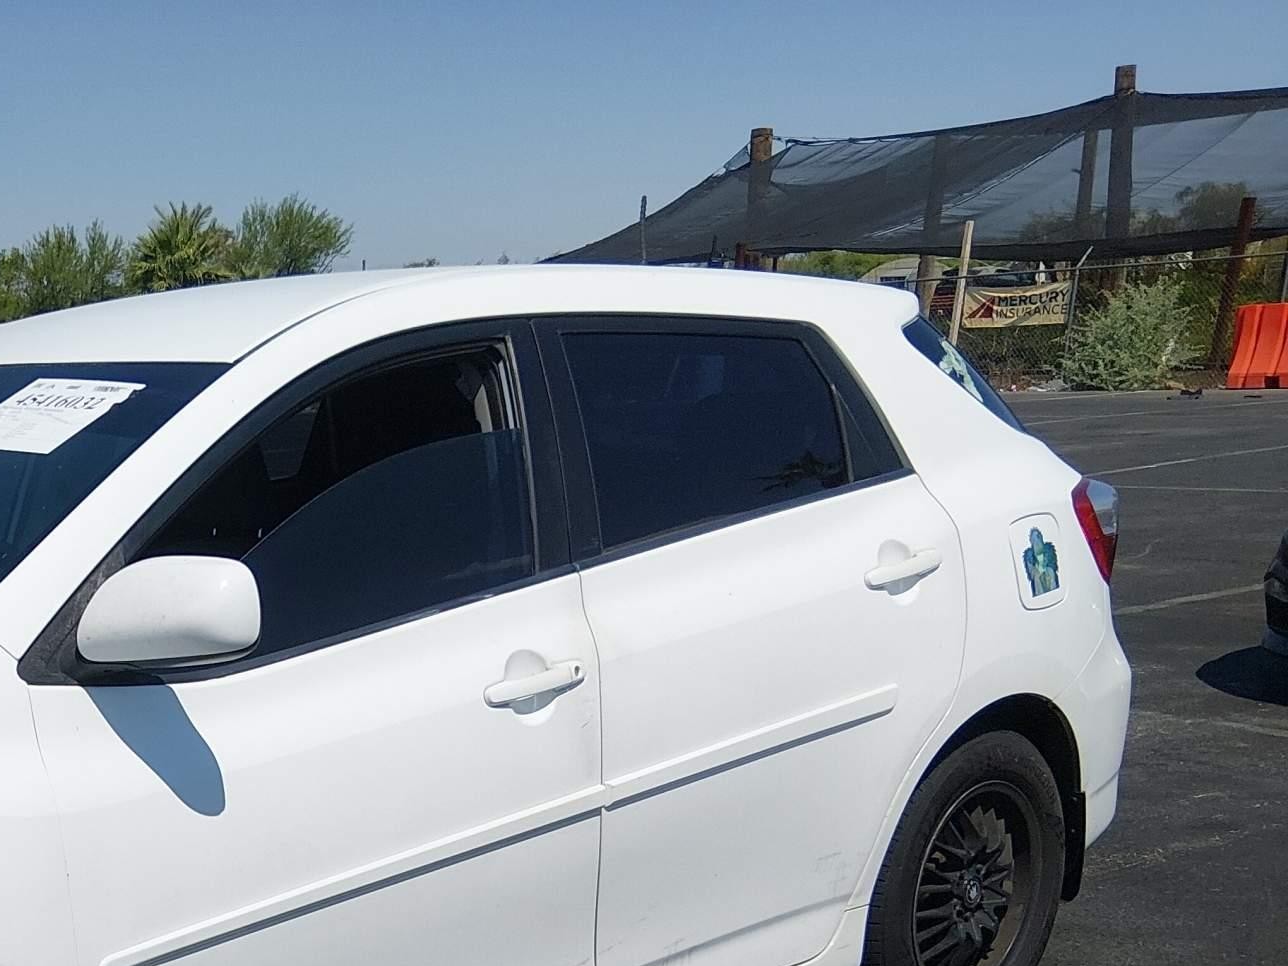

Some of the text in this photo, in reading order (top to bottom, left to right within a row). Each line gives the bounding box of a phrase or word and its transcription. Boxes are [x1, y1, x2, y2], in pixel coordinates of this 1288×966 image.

[996, 289, 1069, 307] MERCURY
[995, 303, 1068, 319] INSURANCE
[15, 393, 107, 410] 45416032
